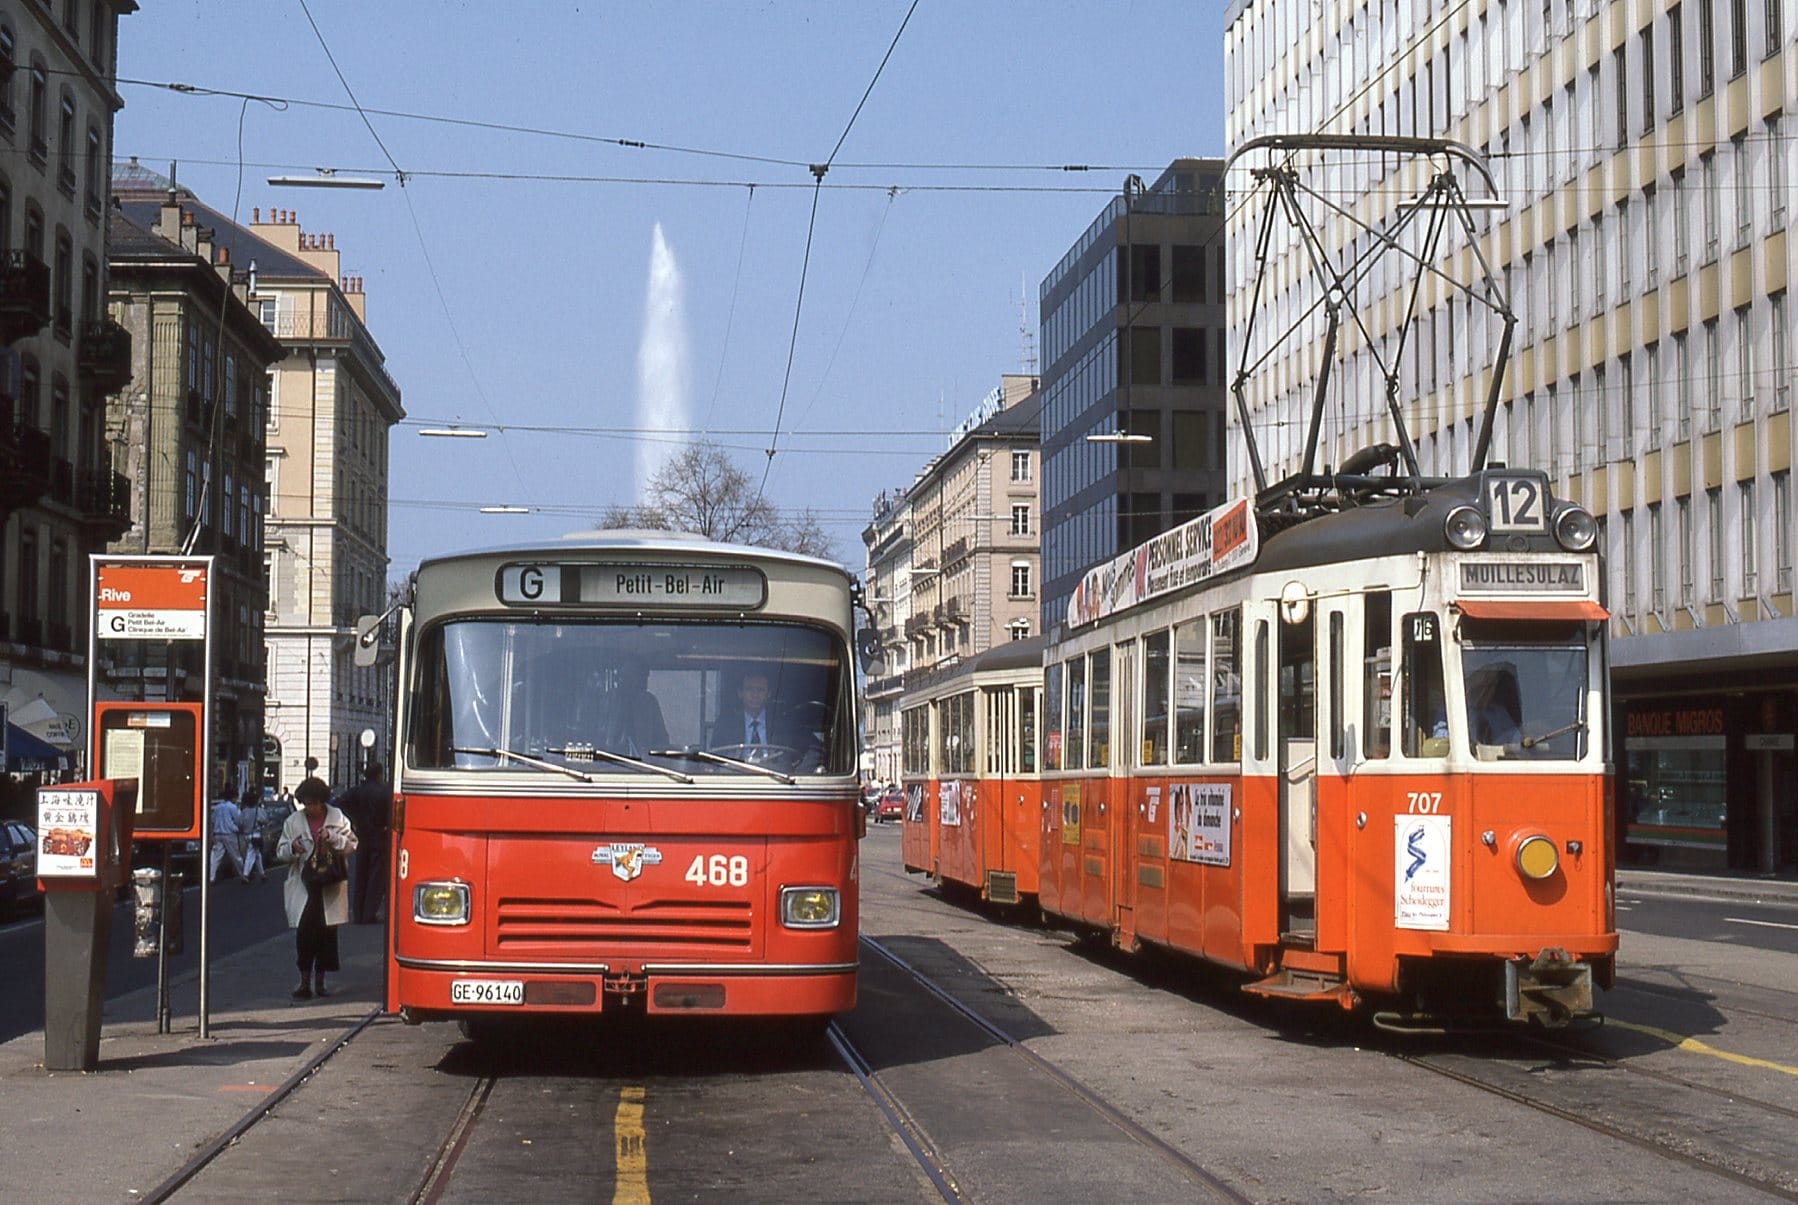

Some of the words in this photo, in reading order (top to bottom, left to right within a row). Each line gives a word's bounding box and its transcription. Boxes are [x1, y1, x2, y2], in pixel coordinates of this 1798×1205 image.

[1494, 479, 1540, 526] 12
[1148, 530, 1185, 574] PERSONNEL
[1185, 514, 1212, 559] SERVICE
[519, 566, 545, 599] G
[616, 573, 726, 595] Petit-Bel-Air
[1466, 564, 1580, 584] MOILLESULAZ
[101, 588, 131, 602] Rive
[110, 616, 125, 633] G
[1627, 711, 1672, 735] BANQUE
[1676, 709, 1723, 733] MIGROS
[1407, 793, 1442, 815] 707
[684, 855, 749, 887] 468
